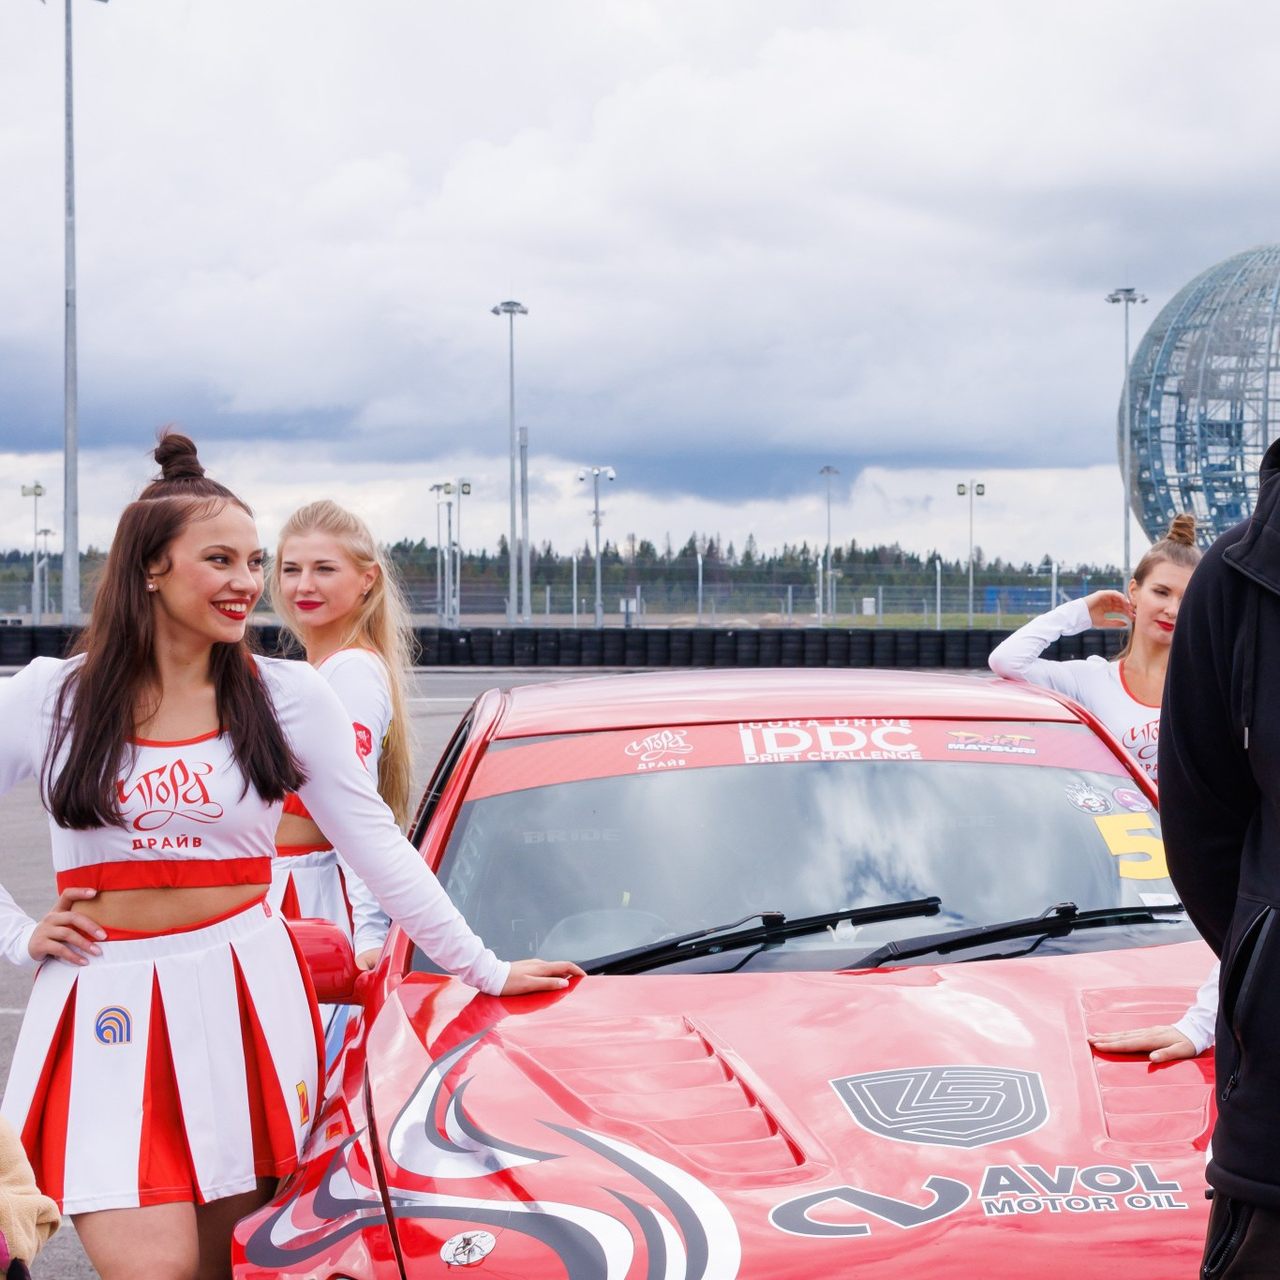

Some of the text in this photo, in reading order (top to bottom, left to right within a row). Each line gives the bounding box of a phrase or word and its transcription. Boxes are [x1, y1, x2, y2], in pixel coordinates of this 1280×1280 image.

[739, 726, 919, 754] IDDC
[948, 744, 1036, 754] MATSURI
[637, 759, 686, 770] ДРАЙВ
[745, 751, 923, 763] DRIFT CHALLENGE
[132, 834, 202, 850] ДРАЙВ
[1094, 812, 1169, 880] 5
[978, 1164, 1181, 1198] AVOL
[983, 1192, 1189, 1216] MOTOR OIL
